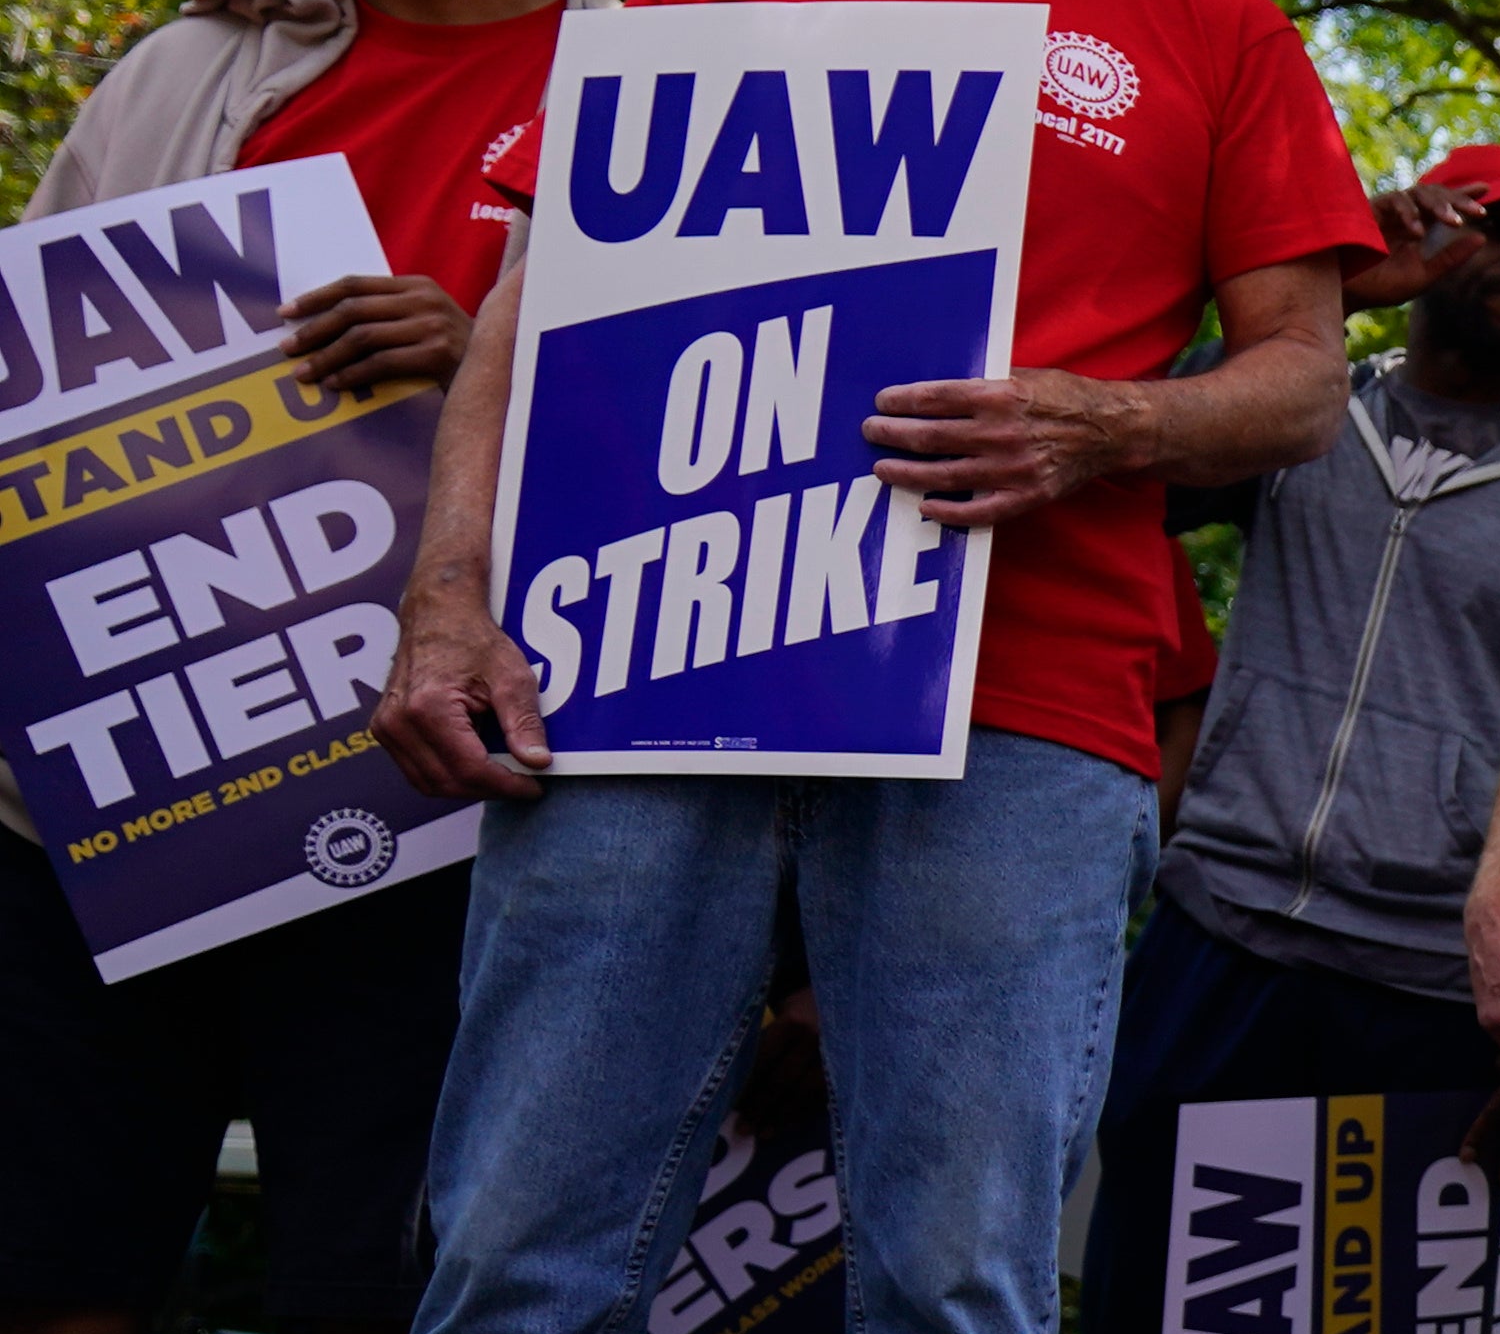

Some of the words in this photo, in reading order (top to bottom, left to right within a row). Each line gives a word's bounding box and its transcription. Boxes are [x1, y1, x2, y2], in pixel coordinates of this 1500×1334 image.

[1036, 109, 1077, 135] ocal
[1057, 55, 1109, 90] UAW
[569, 70, 1003, 244] UAW
[658, 304, 832, 497] ON
[0, 401, 252, 523] TAND
[46, 479, 397, 677] END
[518, 471, 940, 718] STRIKE
[25, 602, 401, 809] TIER
[67, 826, 118, 865] NO
[122, 789, 216, 843] MORE
[221, 765, 283, 807] 2ND
[328, 832, 366, 860] UAW
[1335, 1118, 1375, 1203] UP
[779, 1243, 844, 1299] WORK
